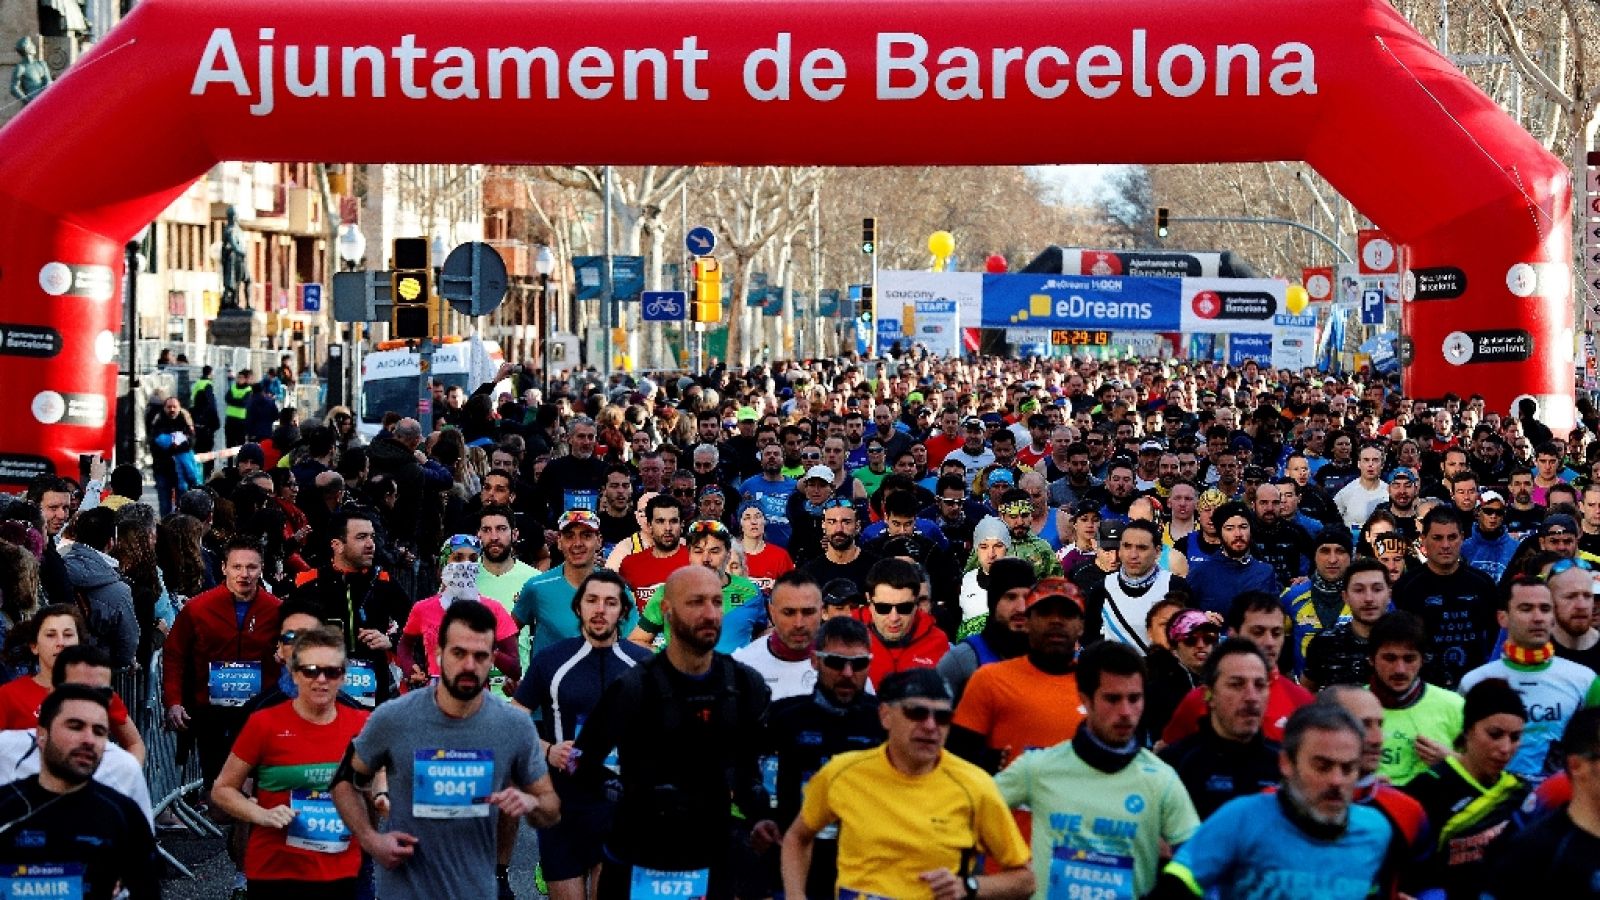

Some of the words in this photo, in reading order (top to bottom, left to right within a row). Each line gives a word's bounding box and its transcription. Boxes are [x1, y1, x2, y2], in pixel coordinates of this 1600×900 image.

[191, 28, 709, 116] Ajuntament
[743, 33, 847, 101] de
[876, 29, 1318, 101] Barcelona
[885, 289, 936, 299] saucony
[1365, 292, 1380, 311] P
[915, 302, 951, 312] START
[1055, 295, 1152, 320] eDreams
[1277, 315, 1313, 325] START
[1443, 611, 1469, 619] RUN
[427, 766, 485, 777] GUILLEM
[433, 780, 477, 797] 9041
[307, 817, 345, 834] 9145
[1050, 813, 1082, 833] WE
[1094, 817, 1138, 840] RUN
[1064, 865, 1124, 886] FERRAN
[12, 881, 70, 896] SAMIR
[651, 880, 693, 896] 1673
